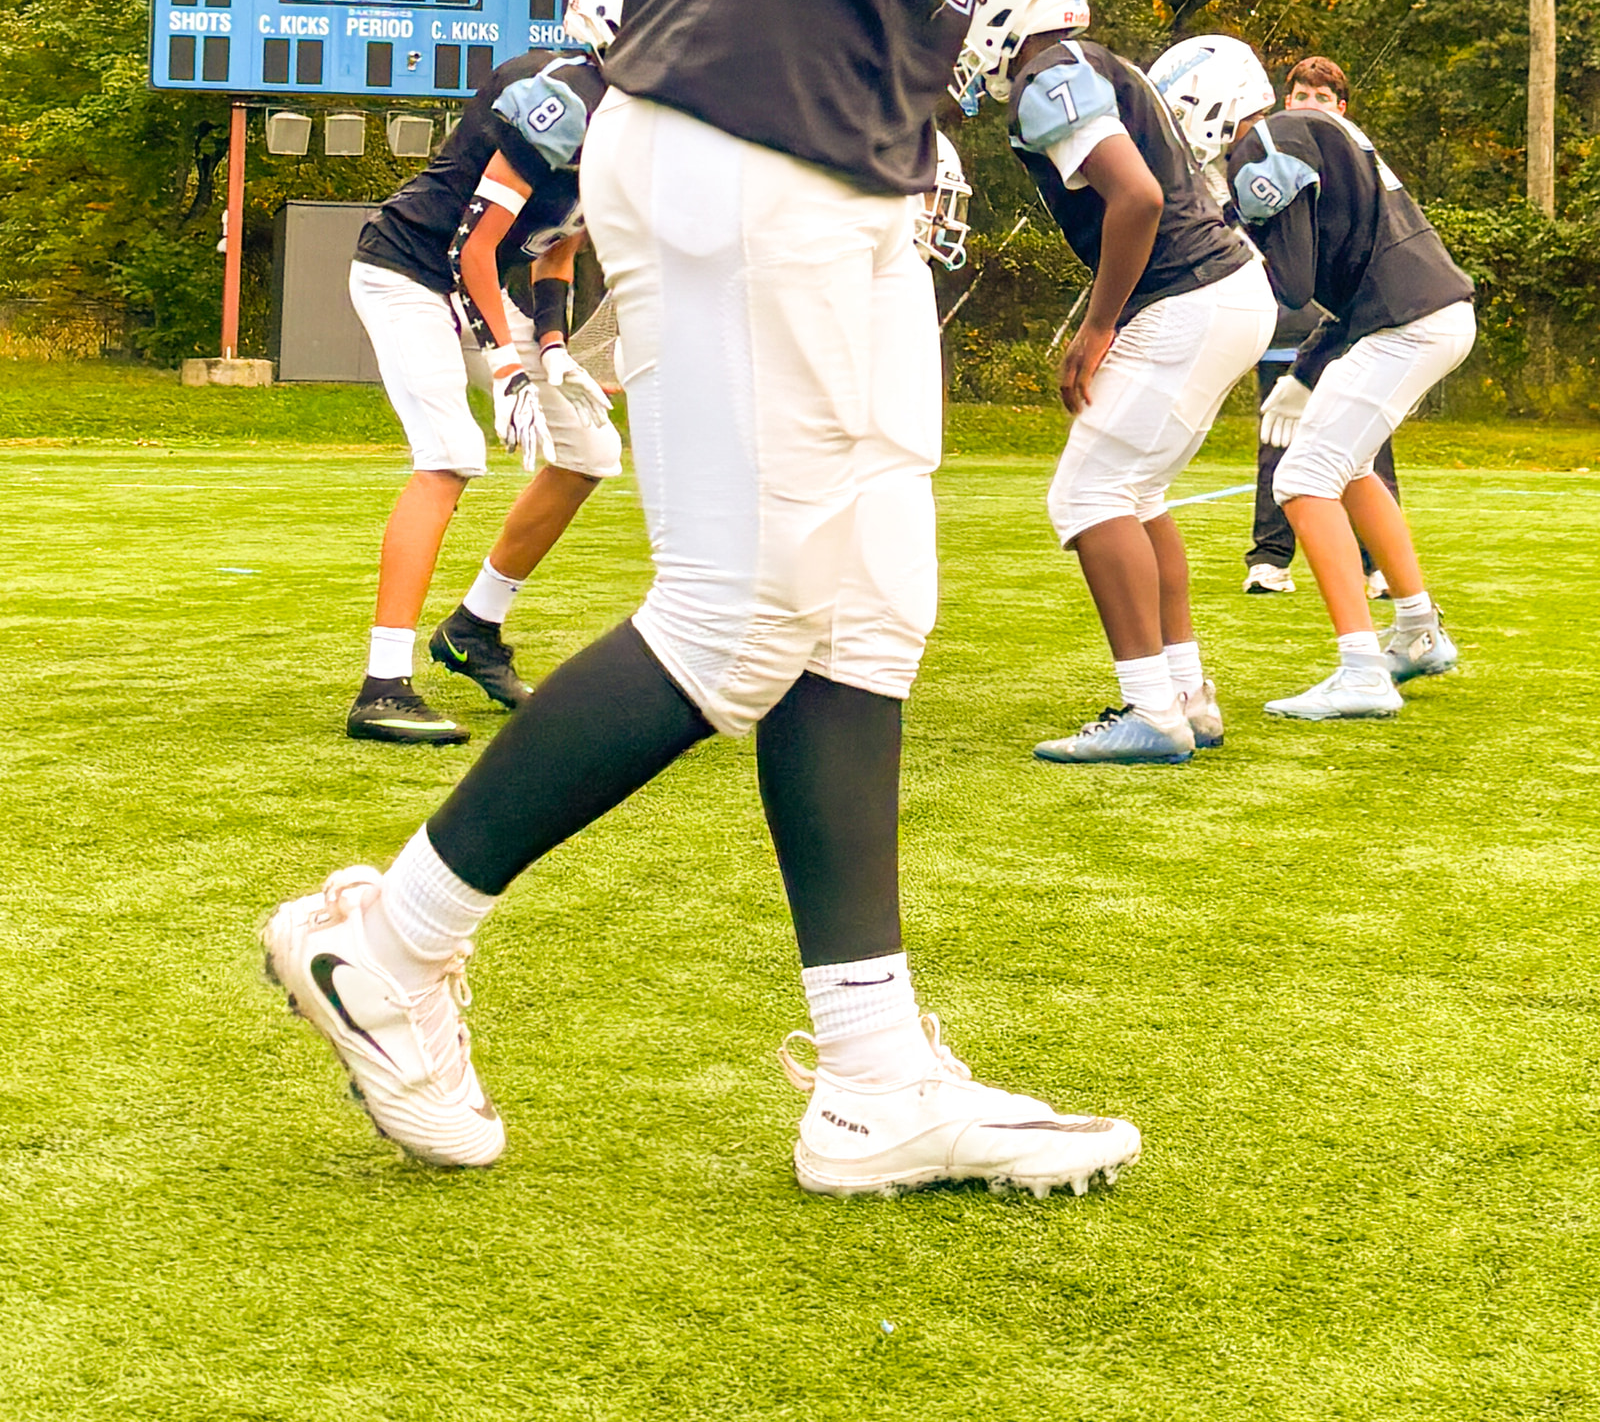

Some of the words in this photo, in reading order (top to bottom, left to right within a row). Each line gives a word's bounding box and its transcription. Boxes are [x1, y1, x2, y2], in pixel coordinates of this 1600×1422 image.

[169, 11, 232, 32] SHOTS
[258, 14, 275, 34] C.
[280, 16, 330, 35] KICKS
[346, 18, 414, 38] PERIOD
[431, 20, 447, 39] C.
[451, 21, 499, 41] KICKS
[1046, 80, 1079, 125] 7
[527, 94, 567, 133] 8
[1250, 175, 1283, 208] 9
